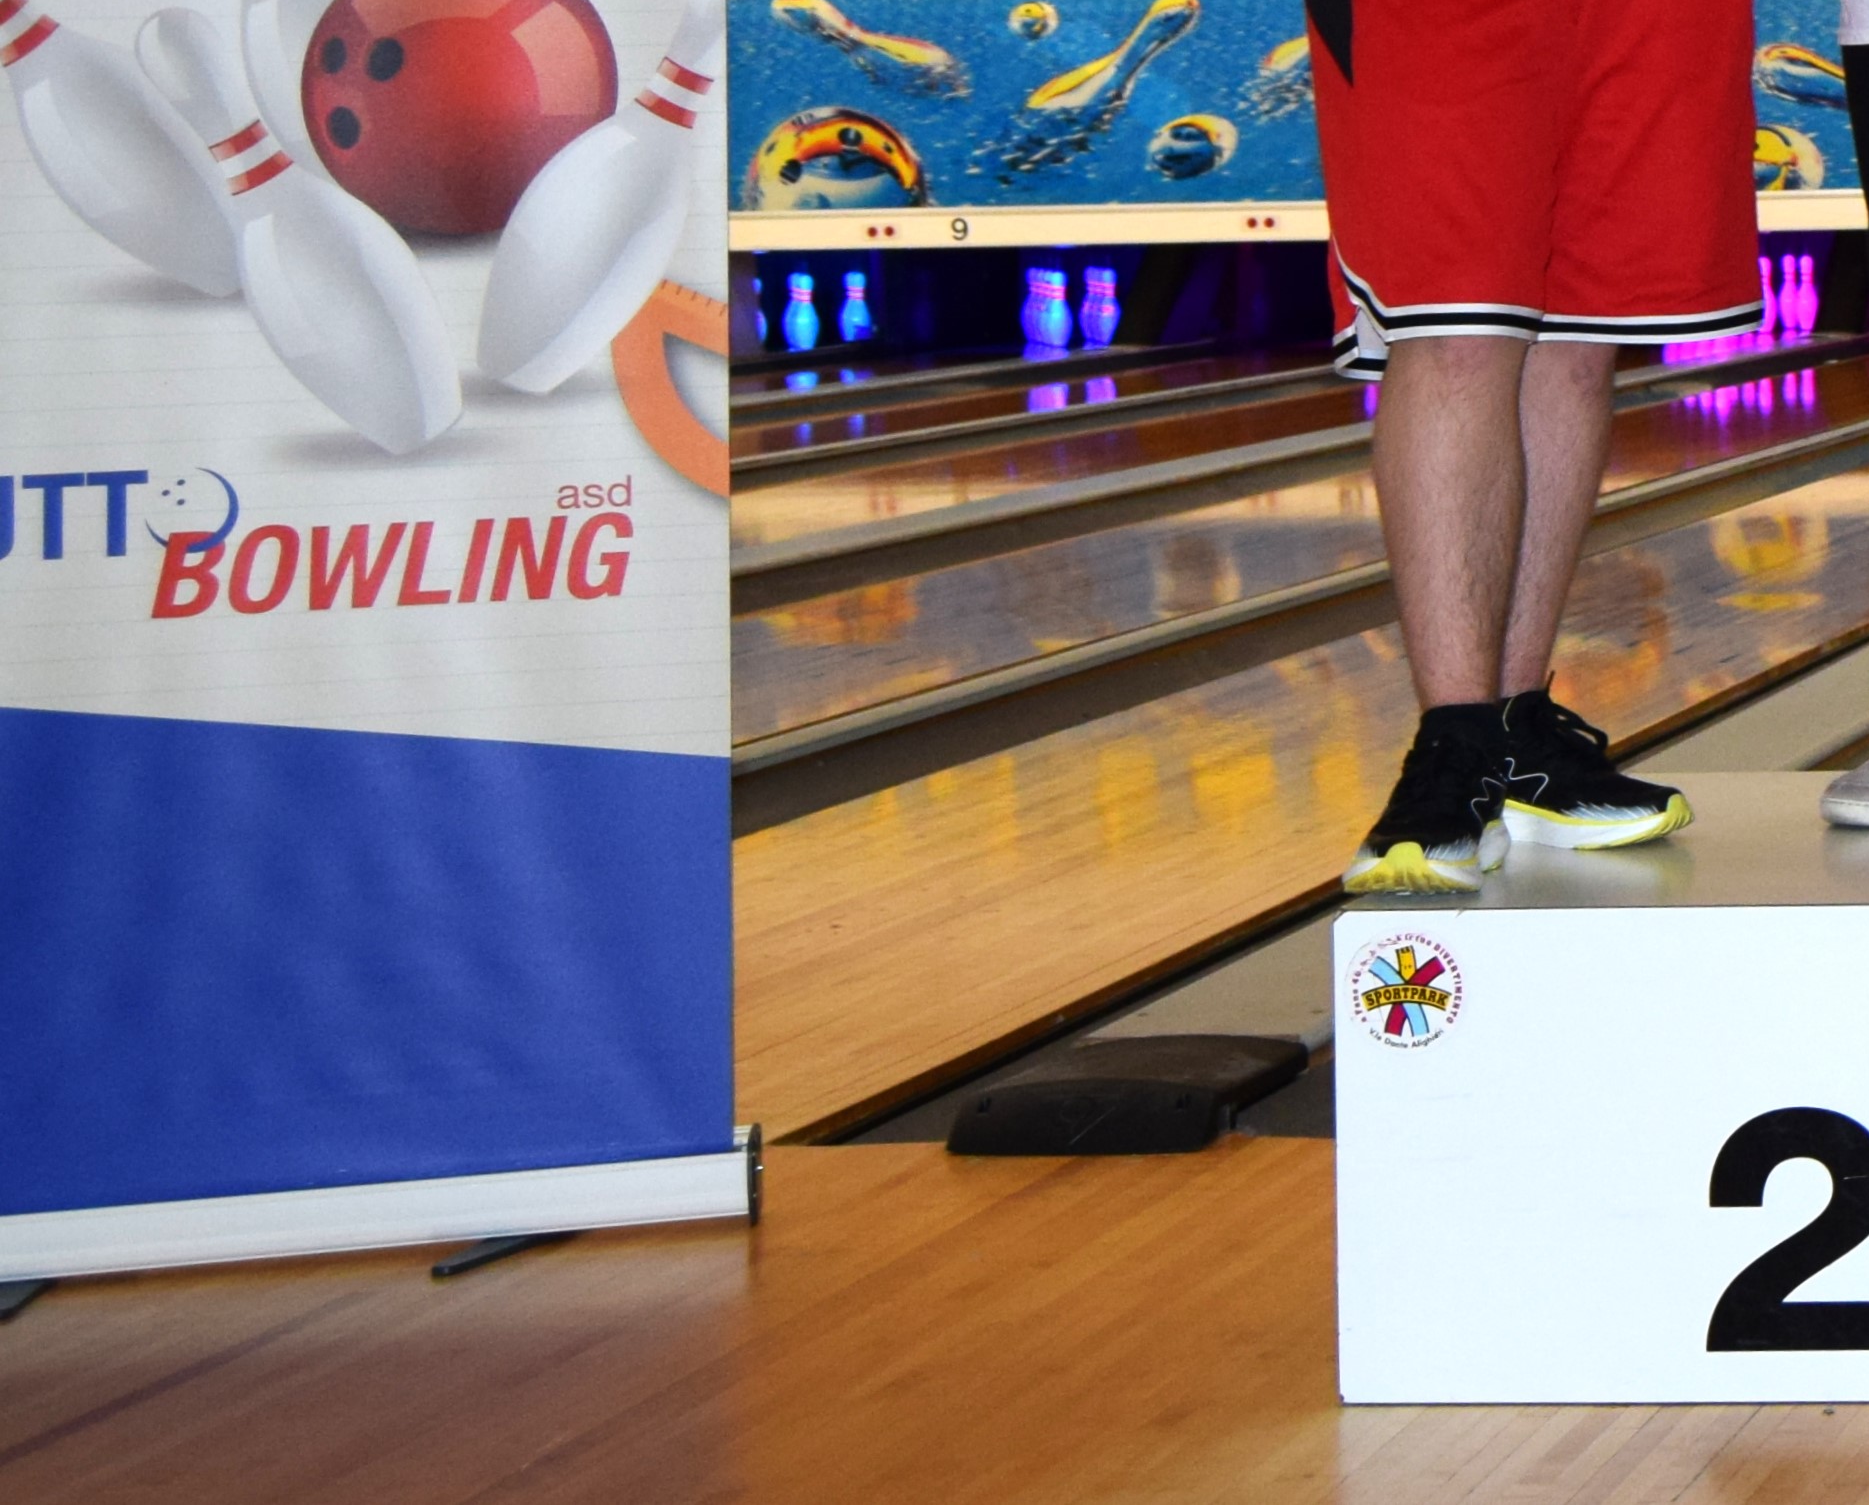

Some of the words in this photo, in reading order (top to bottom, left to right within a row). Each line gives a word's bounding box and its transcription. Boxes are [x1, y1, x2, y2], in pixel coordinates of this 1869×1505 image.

[951, 217, 968, 241] 9
[557, 475, 634, 510] asd
[150, 512, 635, 620] BOWLING
[1365, 988, 1449, 1007] SPORTPARK
